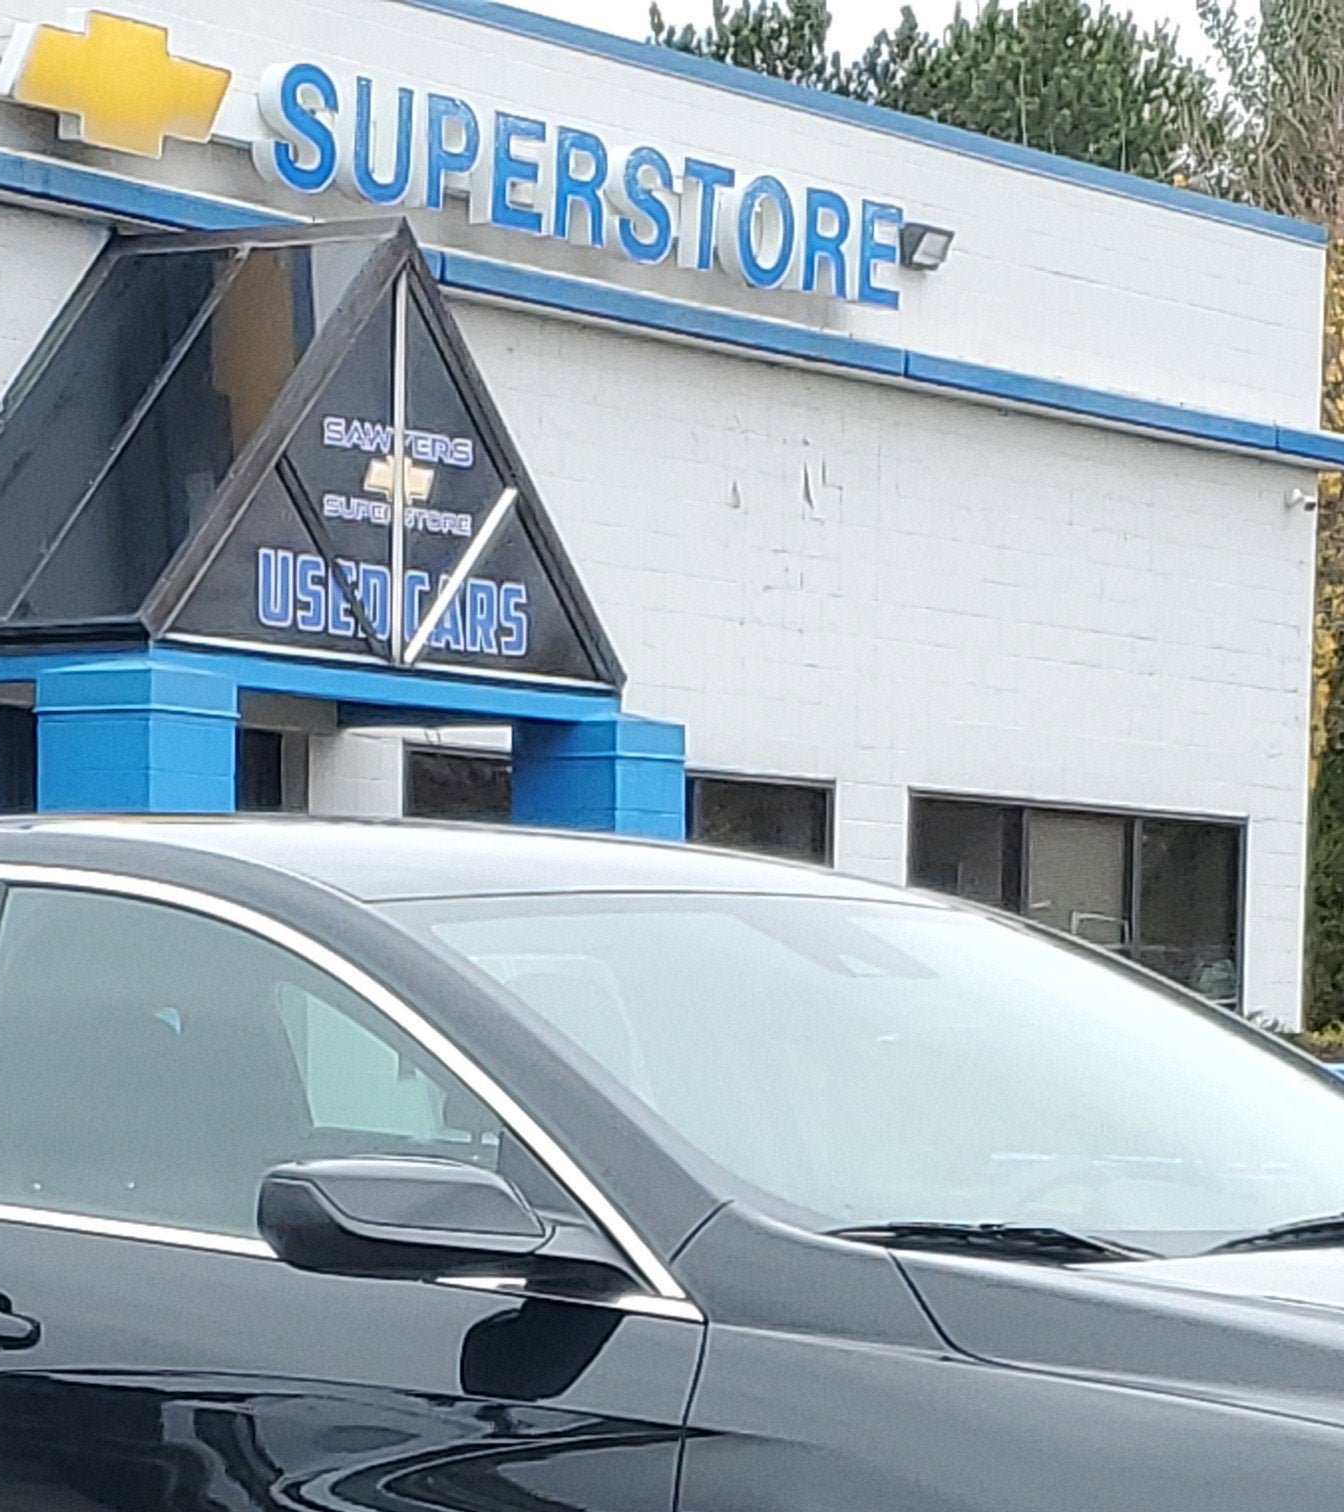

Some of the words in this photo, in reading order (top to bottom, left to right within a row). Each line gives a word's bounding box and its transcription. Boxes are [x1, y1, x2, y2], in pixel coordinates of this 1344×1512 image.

[268, 62, 904, 309] SUPERSTORE
[322, 493, 472, 537] SUPESTORE
[258, 548, 391, 641] USED
[404, 569, 528, 656] CARS
